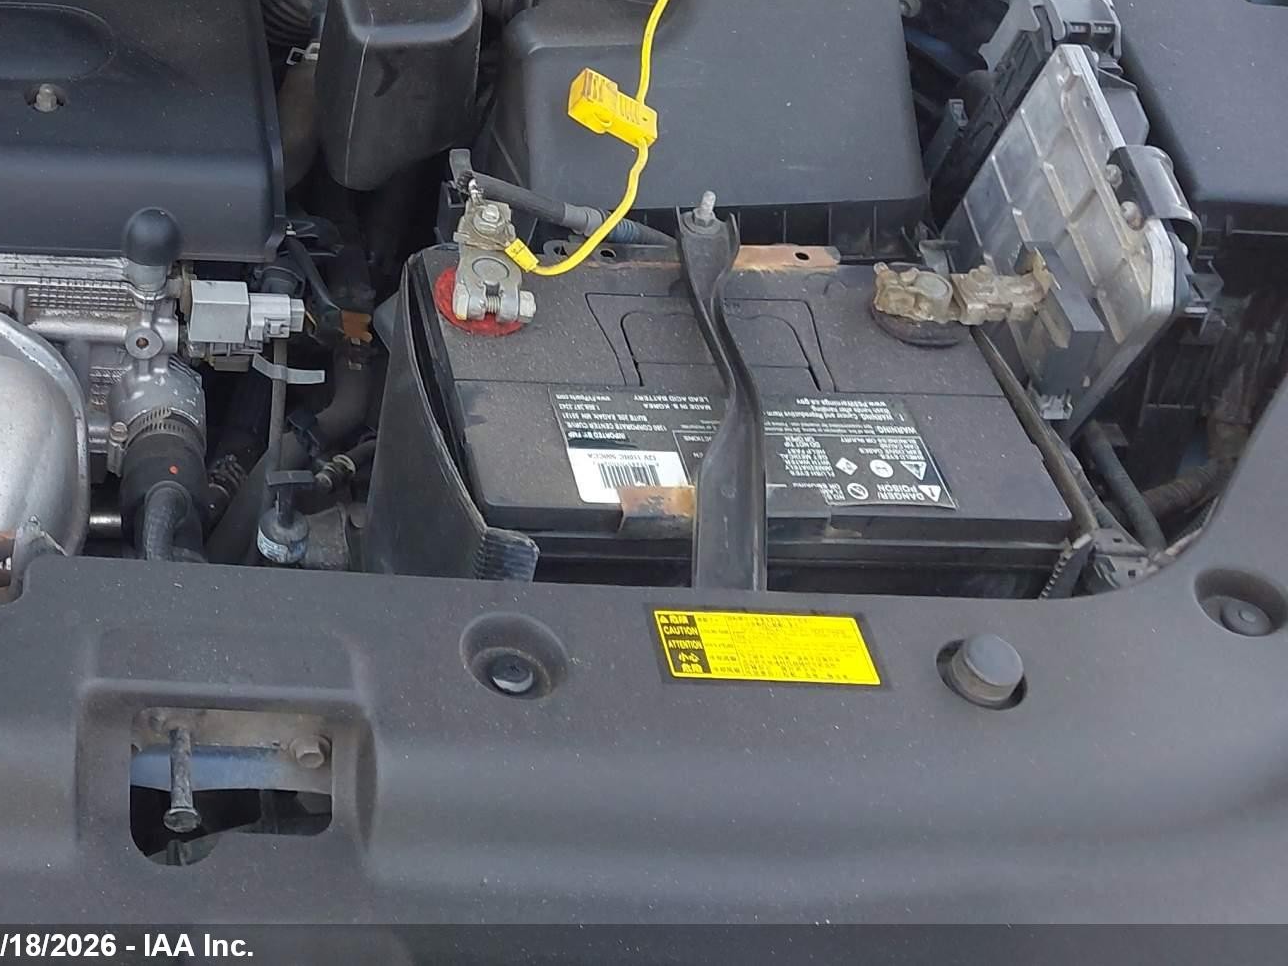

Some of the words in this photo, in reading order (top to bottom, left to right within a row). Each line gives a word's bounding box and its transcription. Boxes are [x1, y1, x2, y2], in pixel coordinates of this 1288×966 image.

[633, 394, 668, 402] BATTERY
[688, 403, 712, 411] MADE
[784, 411, 825, 419] Reproductive
[589, 422, 614, 430] CENTER
[615, 423, 652, 431] CORPORATE
[876, 484, 917, 493] POISON
[663, 626, 699, 635] CAUTION
[668, 639, 703, 650] ATTENTION
